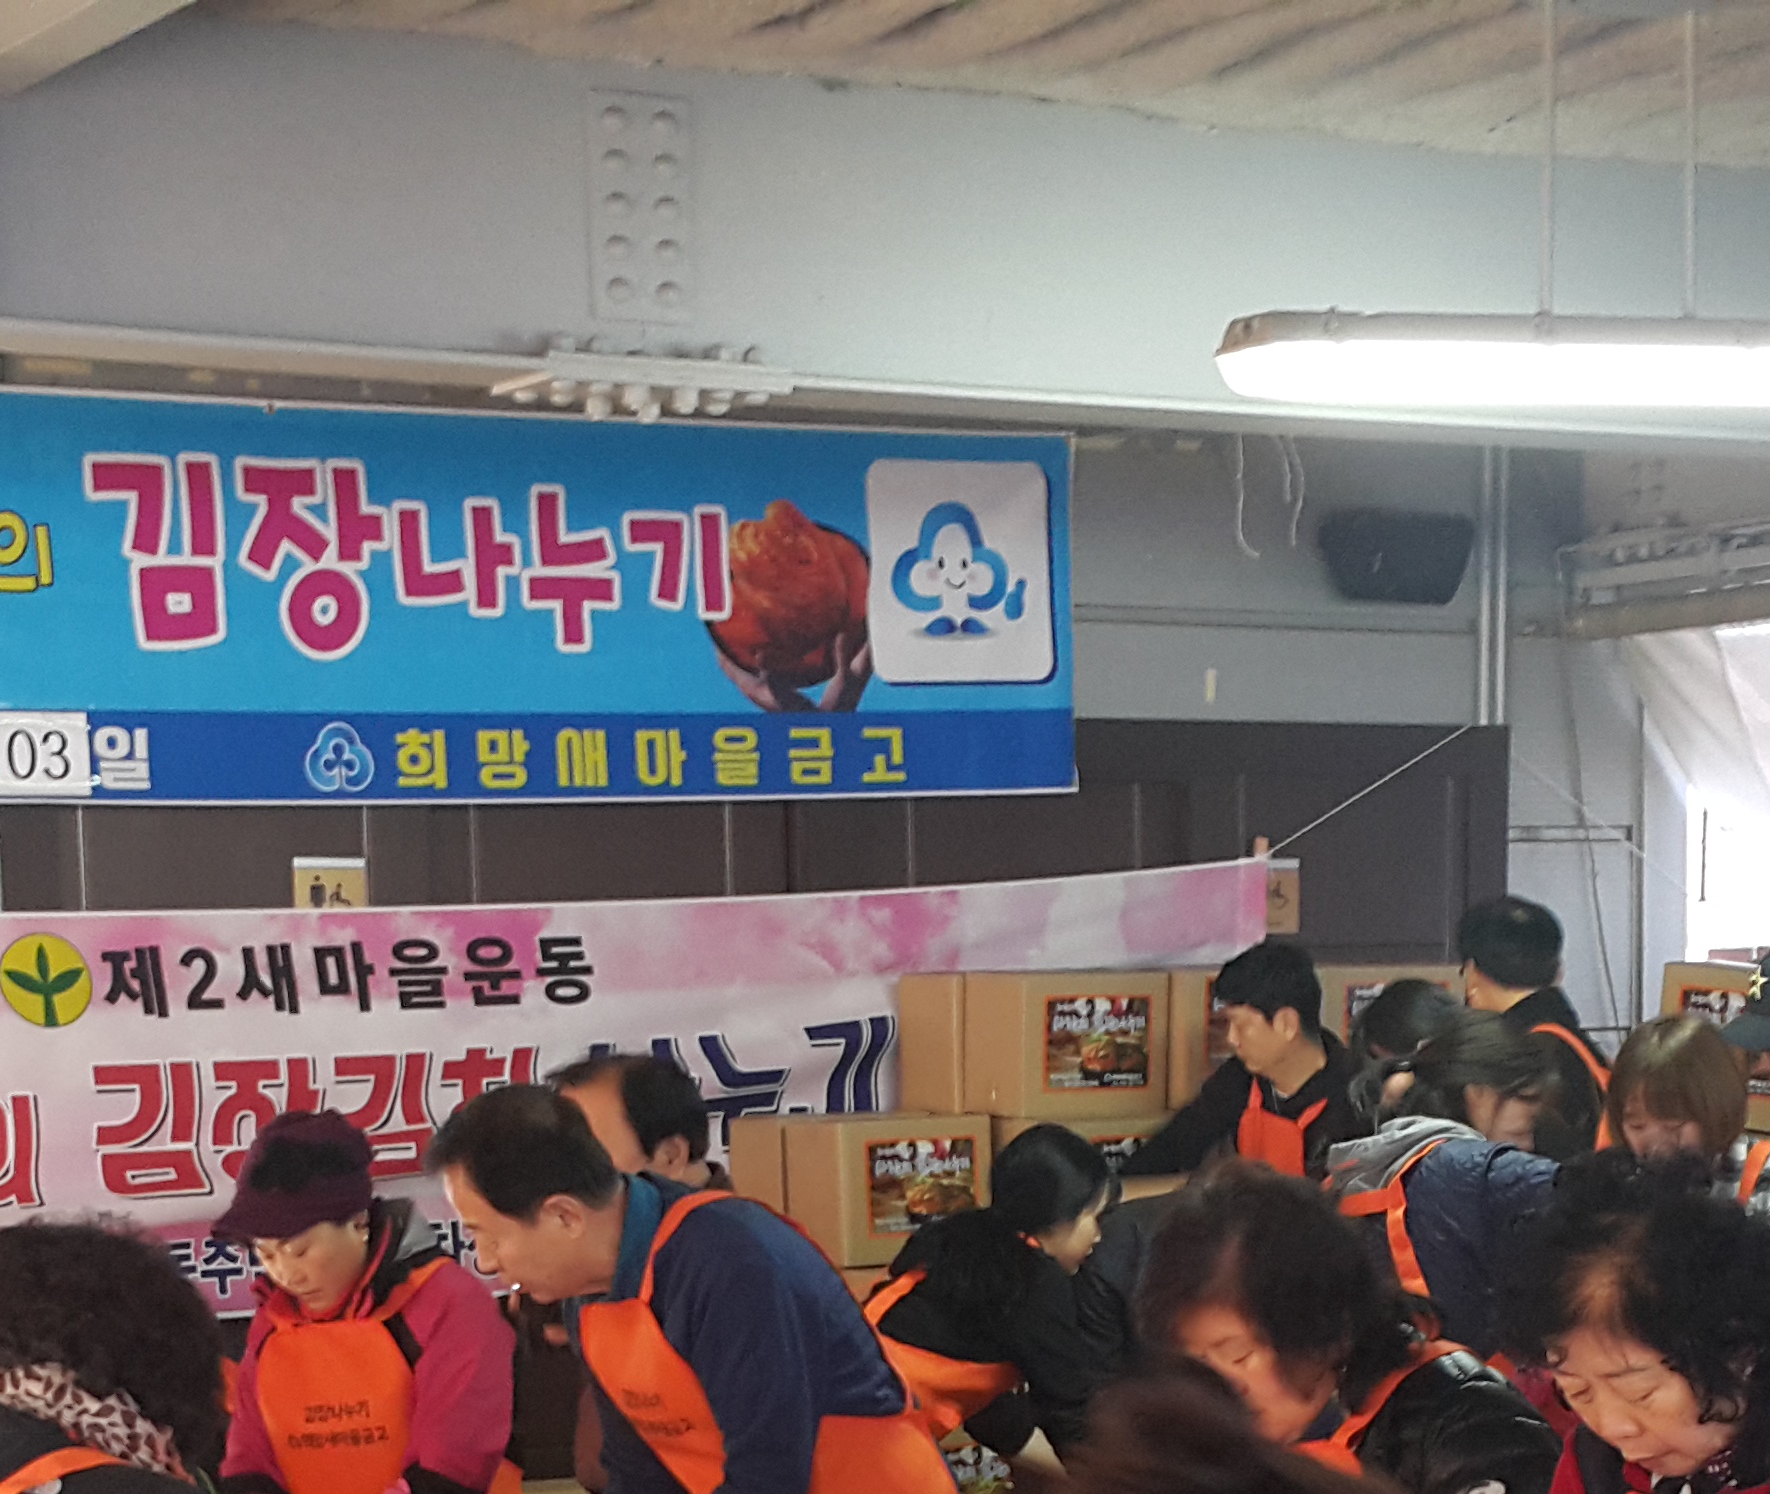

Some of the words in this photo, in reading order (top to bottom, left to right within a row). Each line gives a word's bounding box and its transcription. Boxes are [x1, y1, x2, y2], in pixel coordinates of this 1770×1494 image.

[83, 452, 733, 661] 김장나누기
[394, 725, 908, 790] 희망새마을금고
[101, 936, 593, 1017] 제2새마을운동
[589, 1015, 898, 1146] 누기
